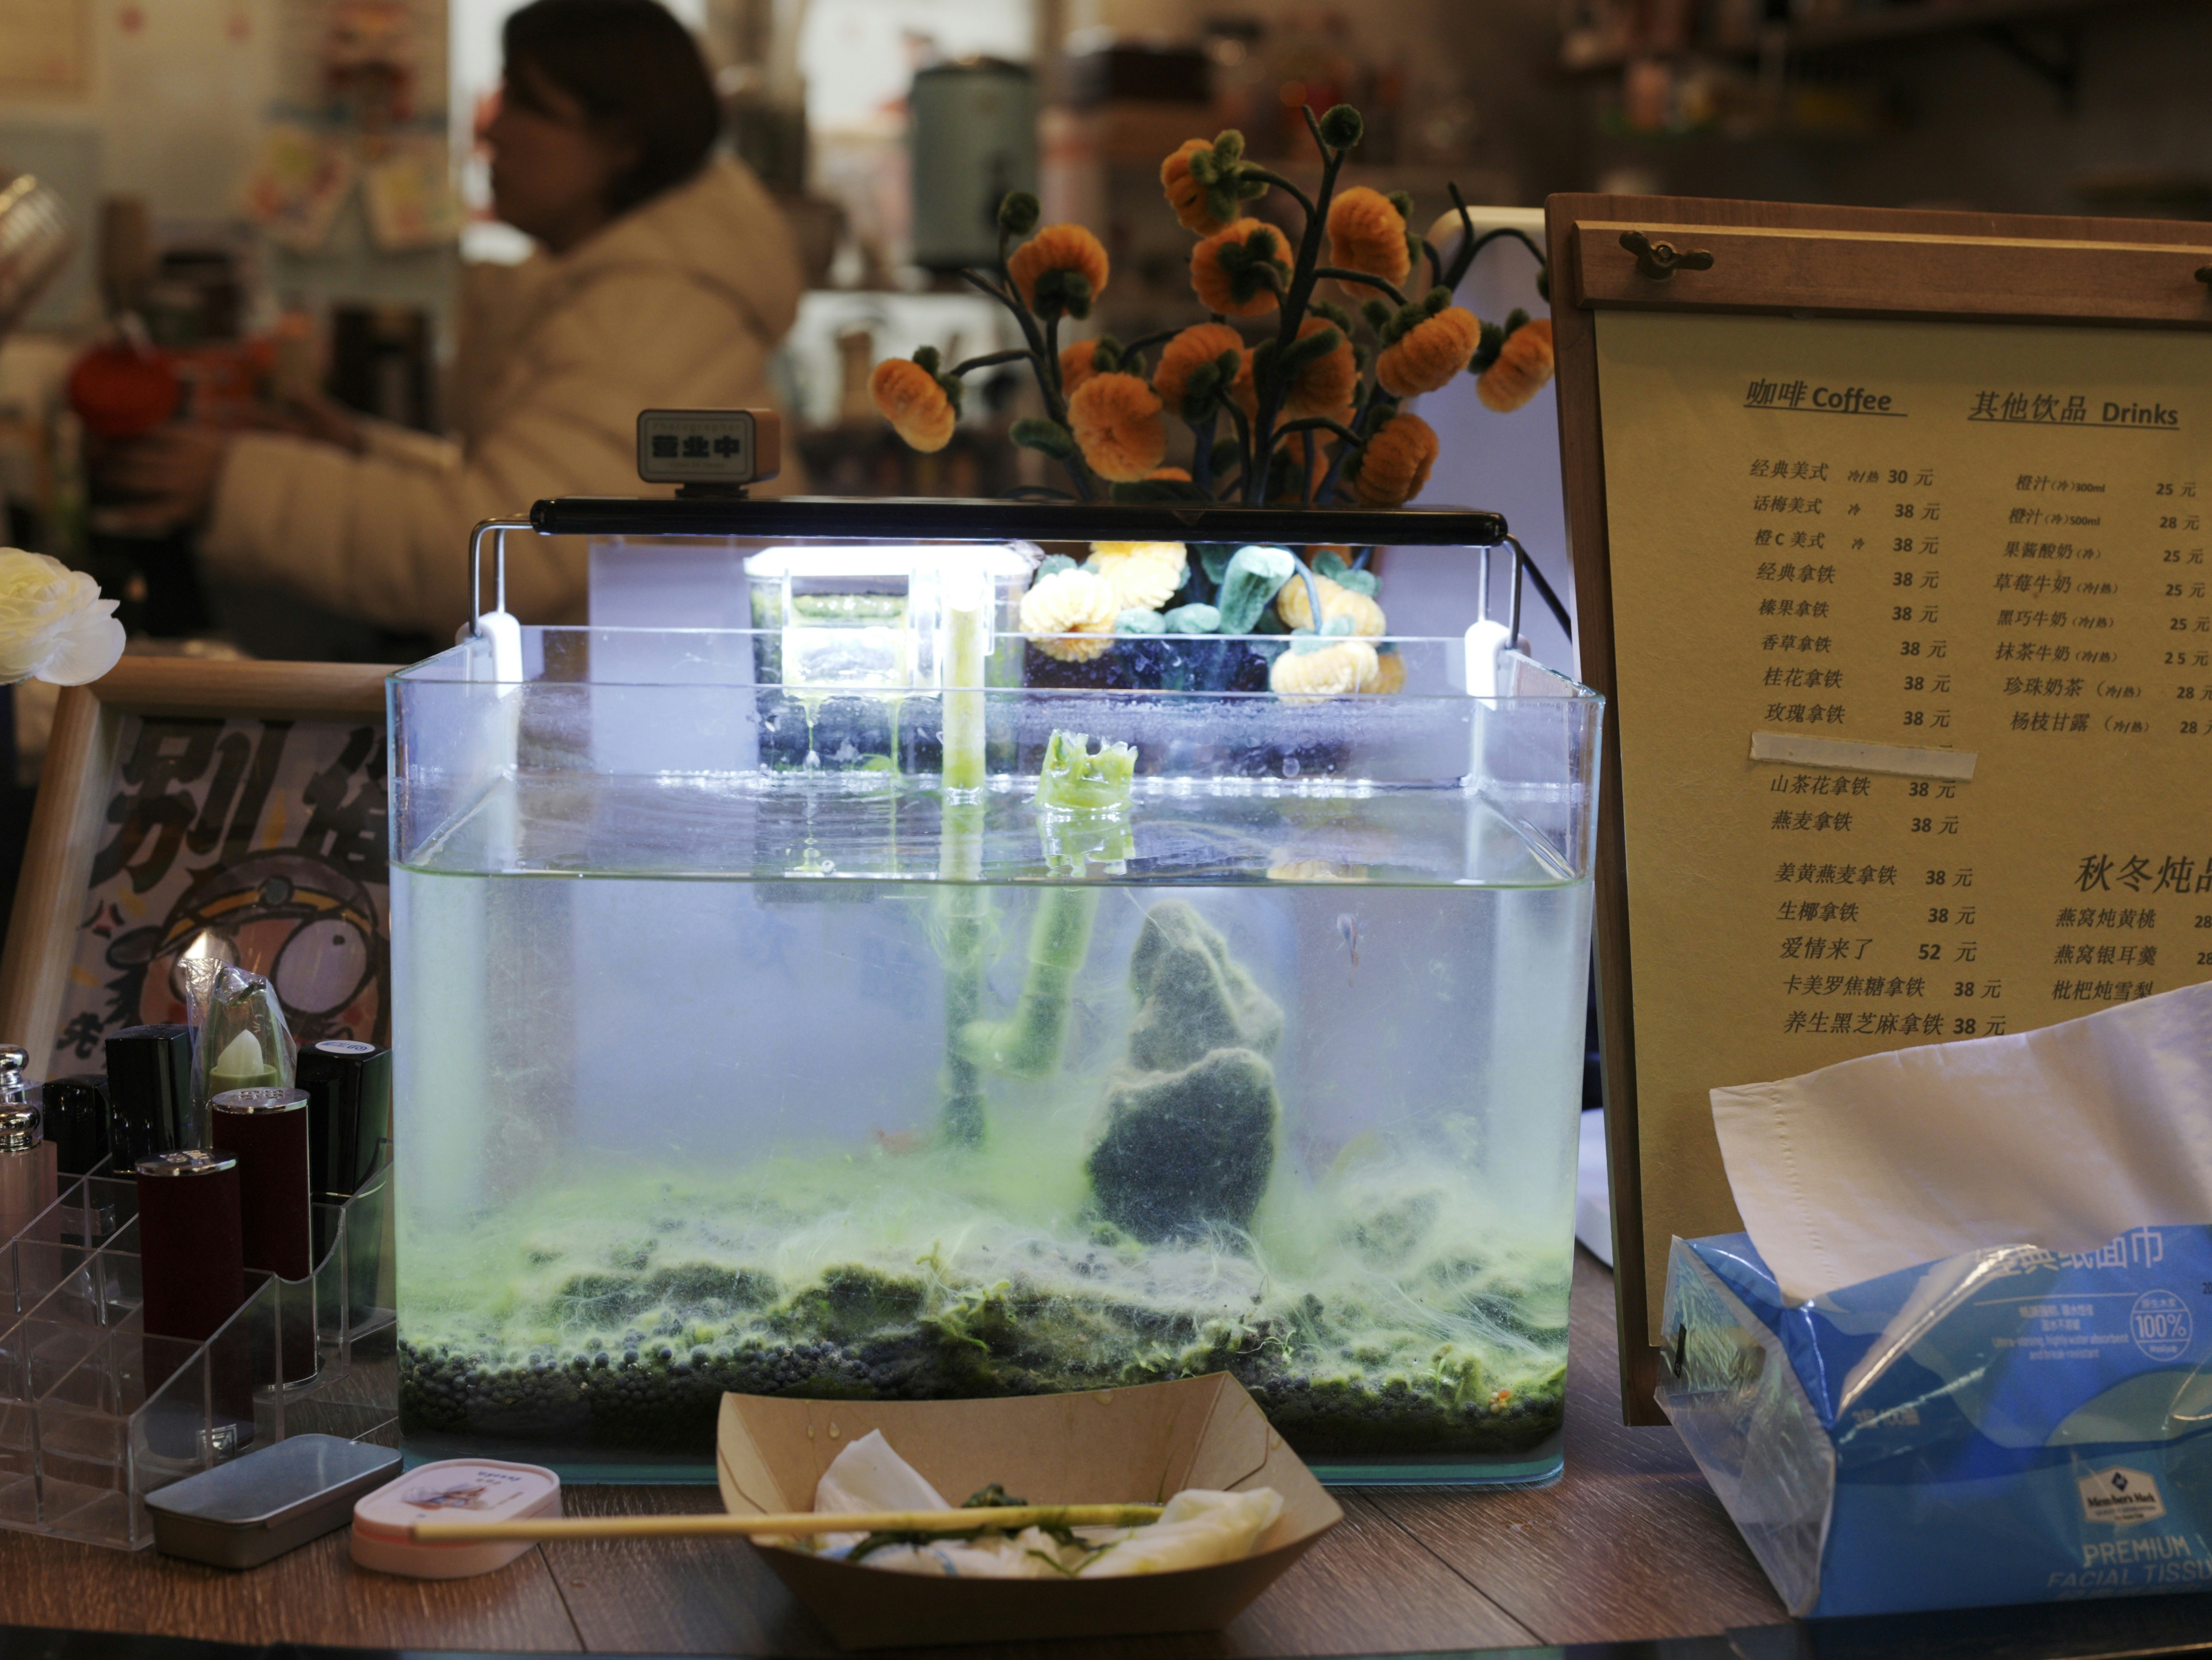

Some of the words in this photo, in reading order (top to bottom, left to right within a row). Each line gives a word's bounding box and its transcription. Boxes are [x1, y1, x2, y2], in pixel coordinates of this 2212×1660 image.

[1968, 390, 2087, 422] 其他饮品
[2101, 402, 2178, 426] Drinks
[652, 435, 740, 458] 营业中
[1750, 459, 1829, 482] 经典美式
[1888, 469, 1908, 484] 30
[1914, 469, 1933, 486] 元
[2156, 483, 2173, 496] 25
[2180, 482, 2195, 497] 元
[1754, 495, 1822, 514] 话梅美式
[1895, 504, 1914, 518] 38
[1921, 503, 1940, 520] 元
[2159, 516, 2177, 529] 28
[2184, 516, 2199, 530] 元
[1893, 537, 1913, 552] 38
[1919, 537, 1938, 554] 元
[2163, 550, 2180, 562] 25
[2187, 549, 2203, 564] 元
[1756, 562, 1836, 584] 经典拿铁
[1893, 572, 1913, 586] 38
[1919, 571, 1939, 589] 元
[2165, 583, 2182, 596] 25
[2189, 583, 2205, 598] 元
[1758, 599, 1829, 618] 榛果拿铁
[1892, 606, 1912, 621] 38
[1919, 605, 1938, 623] 元
[2170, 617, 2187, 631] 25
[2193, 617, 2209, 632] 元
[1762, 634, 1831, 653] 香草拿铁
[1900, 641, 1920, 656] 38
[1927, 640, 1947, 658] 元
[2192, 651, 2209, 666] 元
[1763, 667, 1843, 689] 桂花拿铁
[1904, 676, 1924, 691] 38
[1931, 675, 1950, 692] 元
[2176, 686, 2194, 699] 28
[1764, 703, 1845, 724] 玫瑰拿铁
[1903, 711, 1924, 726] 38
[1930, 709, 1950, 728] 元
[2180, 721, 2198, 734] 28
[1770, 773, 1872, 796] 山茶花拿铁
[1909, 781, 1930, 797] 38
[1933, 779, 1958, 798] 元
[1771, 810, 1852, 831] 燕麦拿铁
[1911, 817, 1932, 833] 38
[1938, 816, 1959, 834] 元
[1774, 862, 1897, 885] 姜黄燕麦拿铁
[1925, 870, 1946, 885] 38
[1952, 868, 1973, 887] 元
[1776, 900, 1859, 922] 生椰拿铁
[1928, 908, 1949, 923] 38
[1955, 906, 1975, 925] 元
[2056, 907, 2156, 929] 燕窝炖黄桃
[2194, 915, 2212, 929] 28
[1779, 936, 1873, 960] 爱情来了
[1918, 944, 1941, 960] 52
[1954, 941, 1977, 962] 元
[2054, 944, 2157, 966] 燕窝银耳羹
[2196, 952, 2212, 965] 28
[1783, 974, 1925, 997] 卡美罗焦糖拿铁
[1954, 981, 1975, 997] 38
[1981, 979, 2001, 998] 元
[1784, 1010, 1944, 1036] 养生黑芝麻拿铁
[1953, 1018, 1977, 1036] 38
[1982, 1015, 2008, 1037] 元
[2135, 1314, 2187, 1338] 100%
[2082, 1535, 2191, 1567] PREMIUM
[2047, 1568, 2132, 1588] FACIAL
